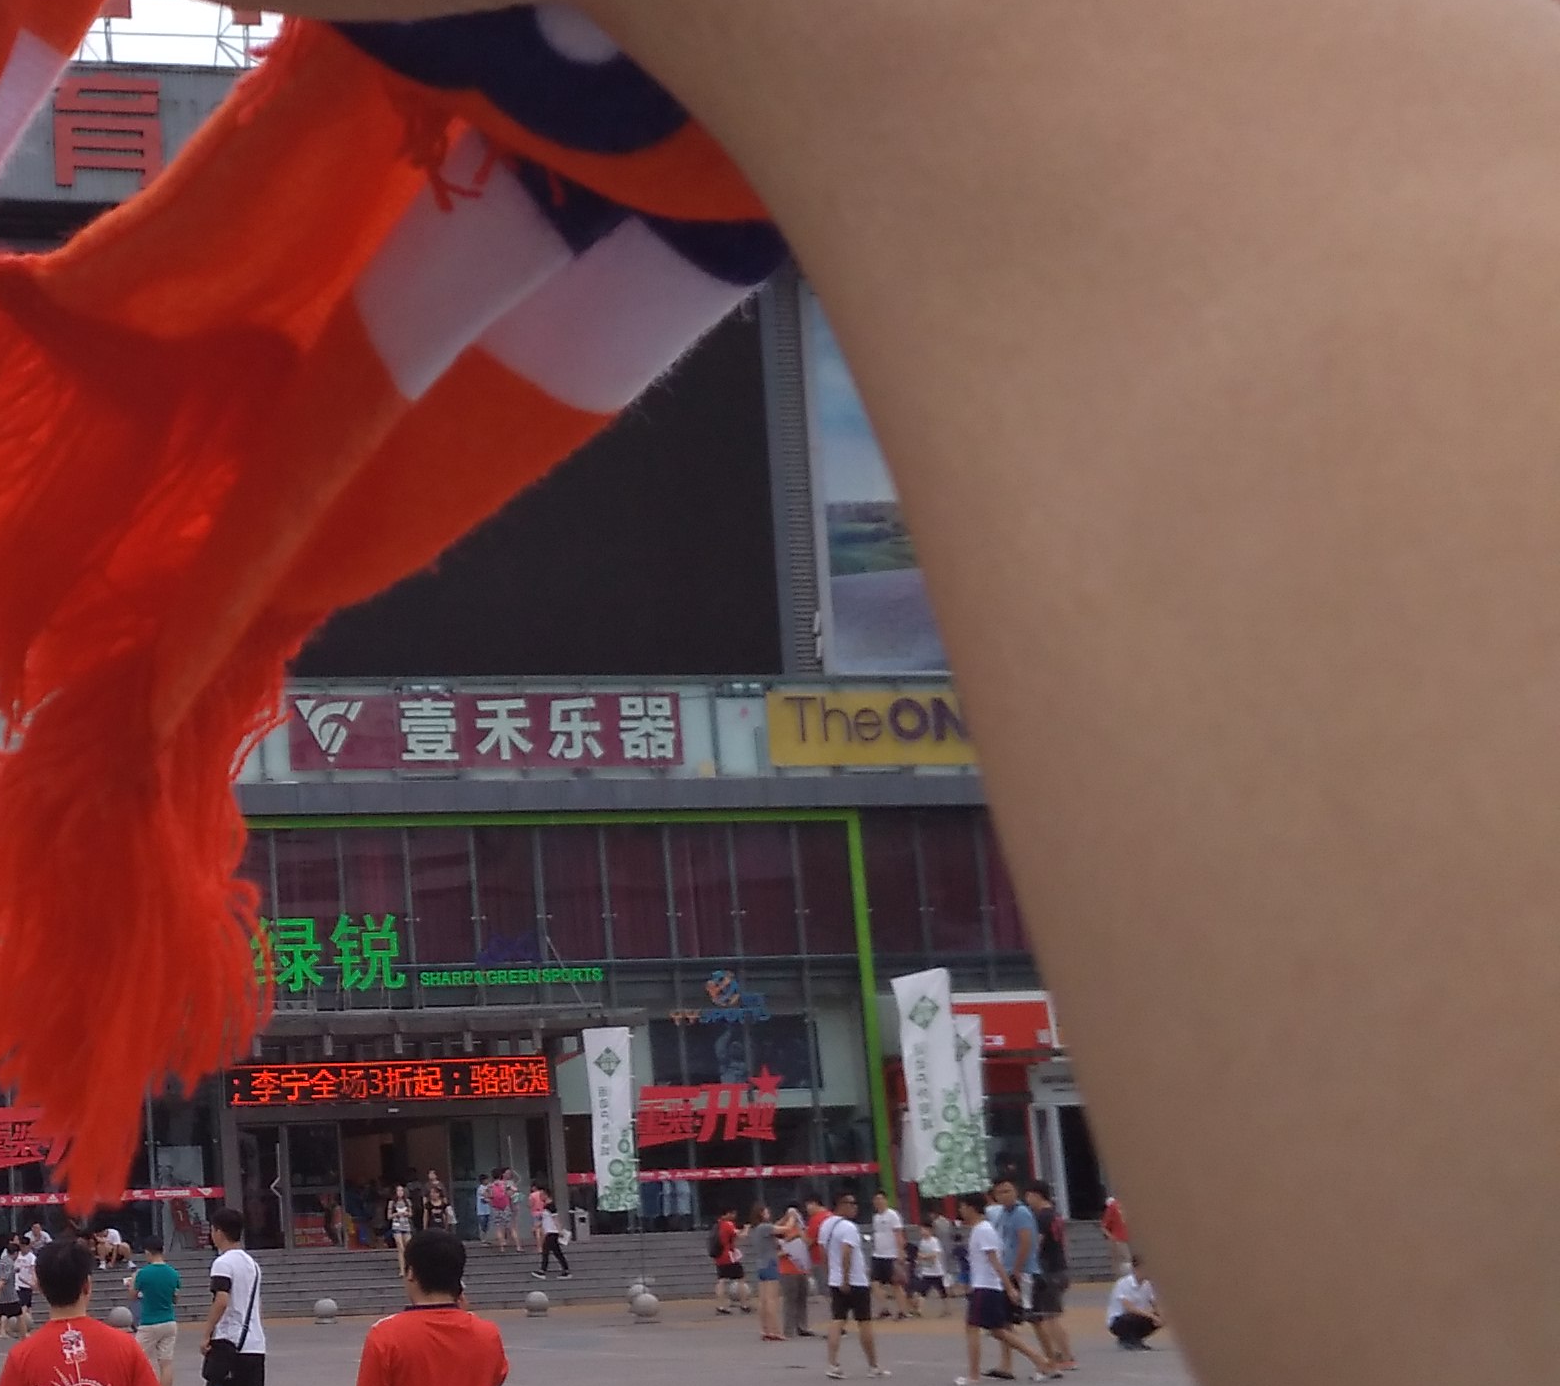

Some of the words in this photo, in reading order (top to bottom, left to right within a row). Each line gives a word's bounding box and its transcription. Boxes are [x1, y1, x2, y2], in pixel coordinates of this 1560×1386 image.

[399, 695, 675, 761] 壹禾乐器
[542, 967, 603, 984] SPORTS
